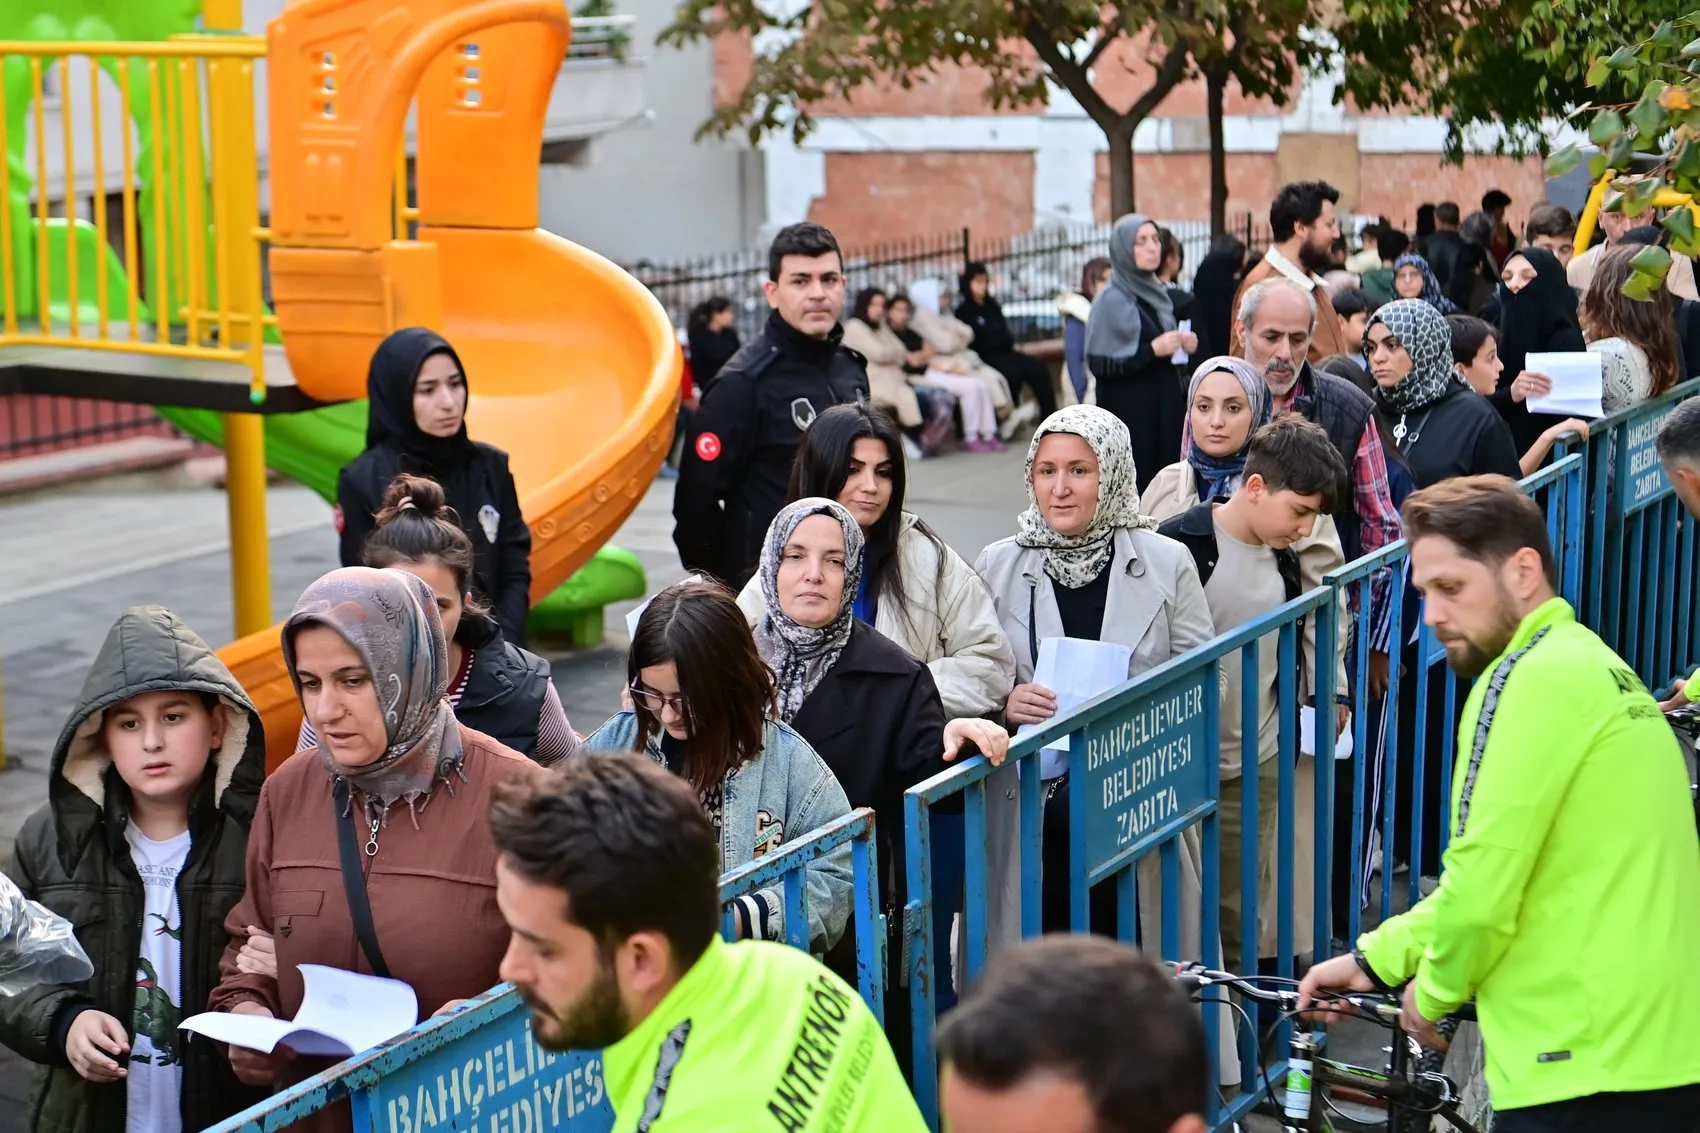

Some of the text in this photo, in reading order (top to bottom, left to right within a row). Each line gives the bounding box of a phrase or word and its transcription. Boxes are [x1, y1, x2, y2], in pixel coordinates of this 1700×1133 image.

[1631, 441, 1662, 476] BELEDİY
[1635, 469, 1661, 500] ZABITA
[1088, 684, 1202, 772] BAHÇELİEVLER
[1117, 785, 1178, 847] ZABITA
[388, 1018, 572, 1133] BAHÇELİ
[766, 975, 850, 1133] ANTRENÖR
